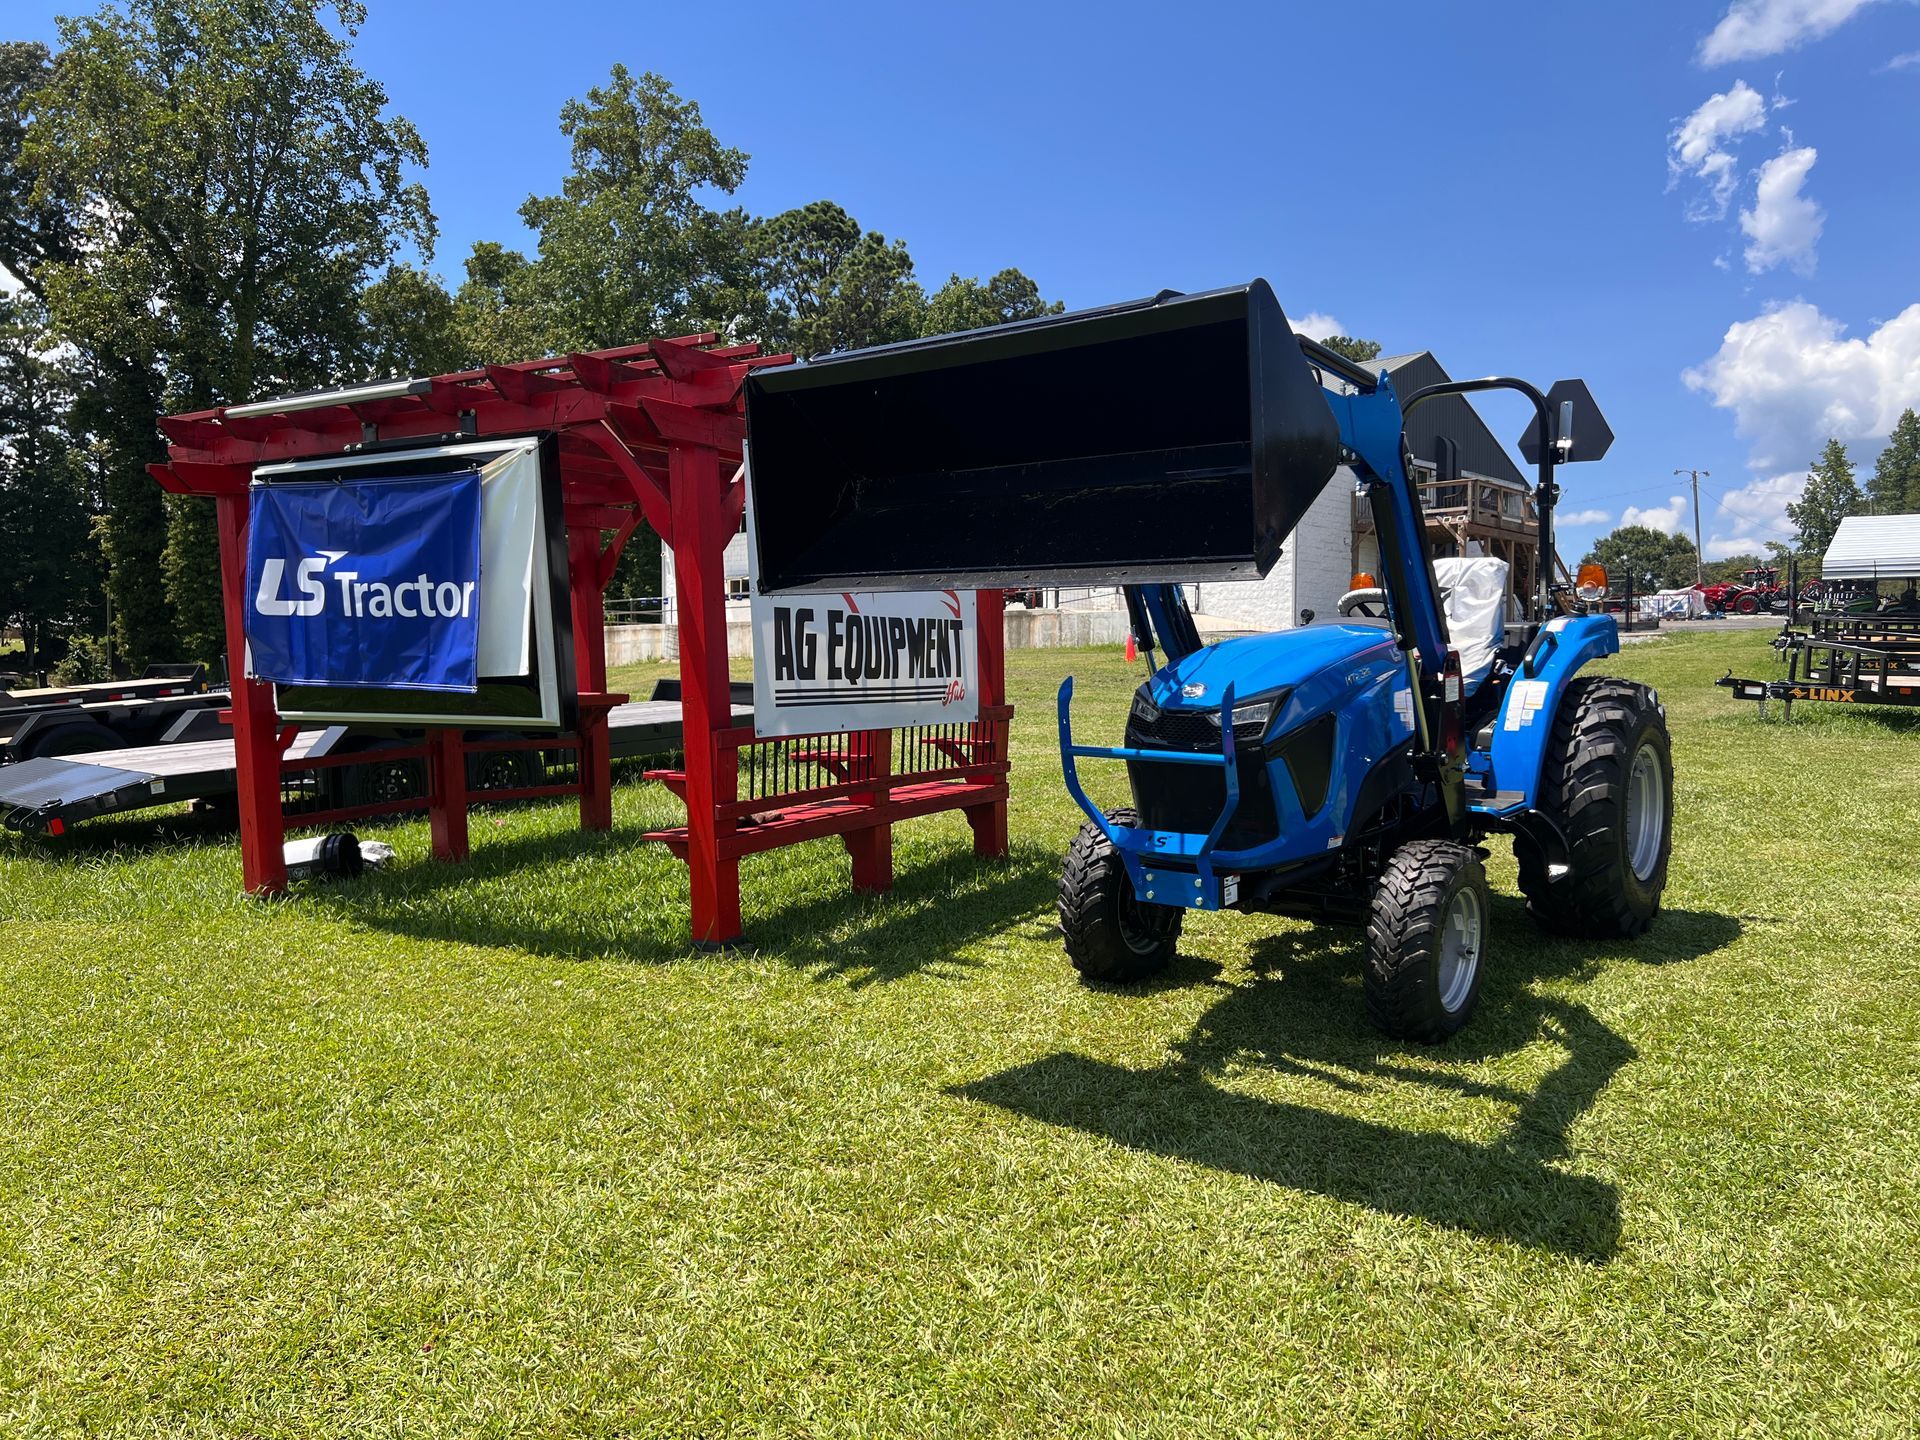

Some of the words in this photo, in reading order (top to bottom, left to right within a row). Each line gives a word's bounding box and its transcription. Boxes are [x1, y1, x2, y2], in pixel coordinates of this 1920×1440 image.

[255, 555, 330, 616] LS
[334, 571, 475, 618] Tractor
[774, 606, 817, 681] AG
[827, 609, 963, 685] EQUIPMENT
[941, 680, 965, 707] Hub
[1809, 687, 1855, 702] LINX
